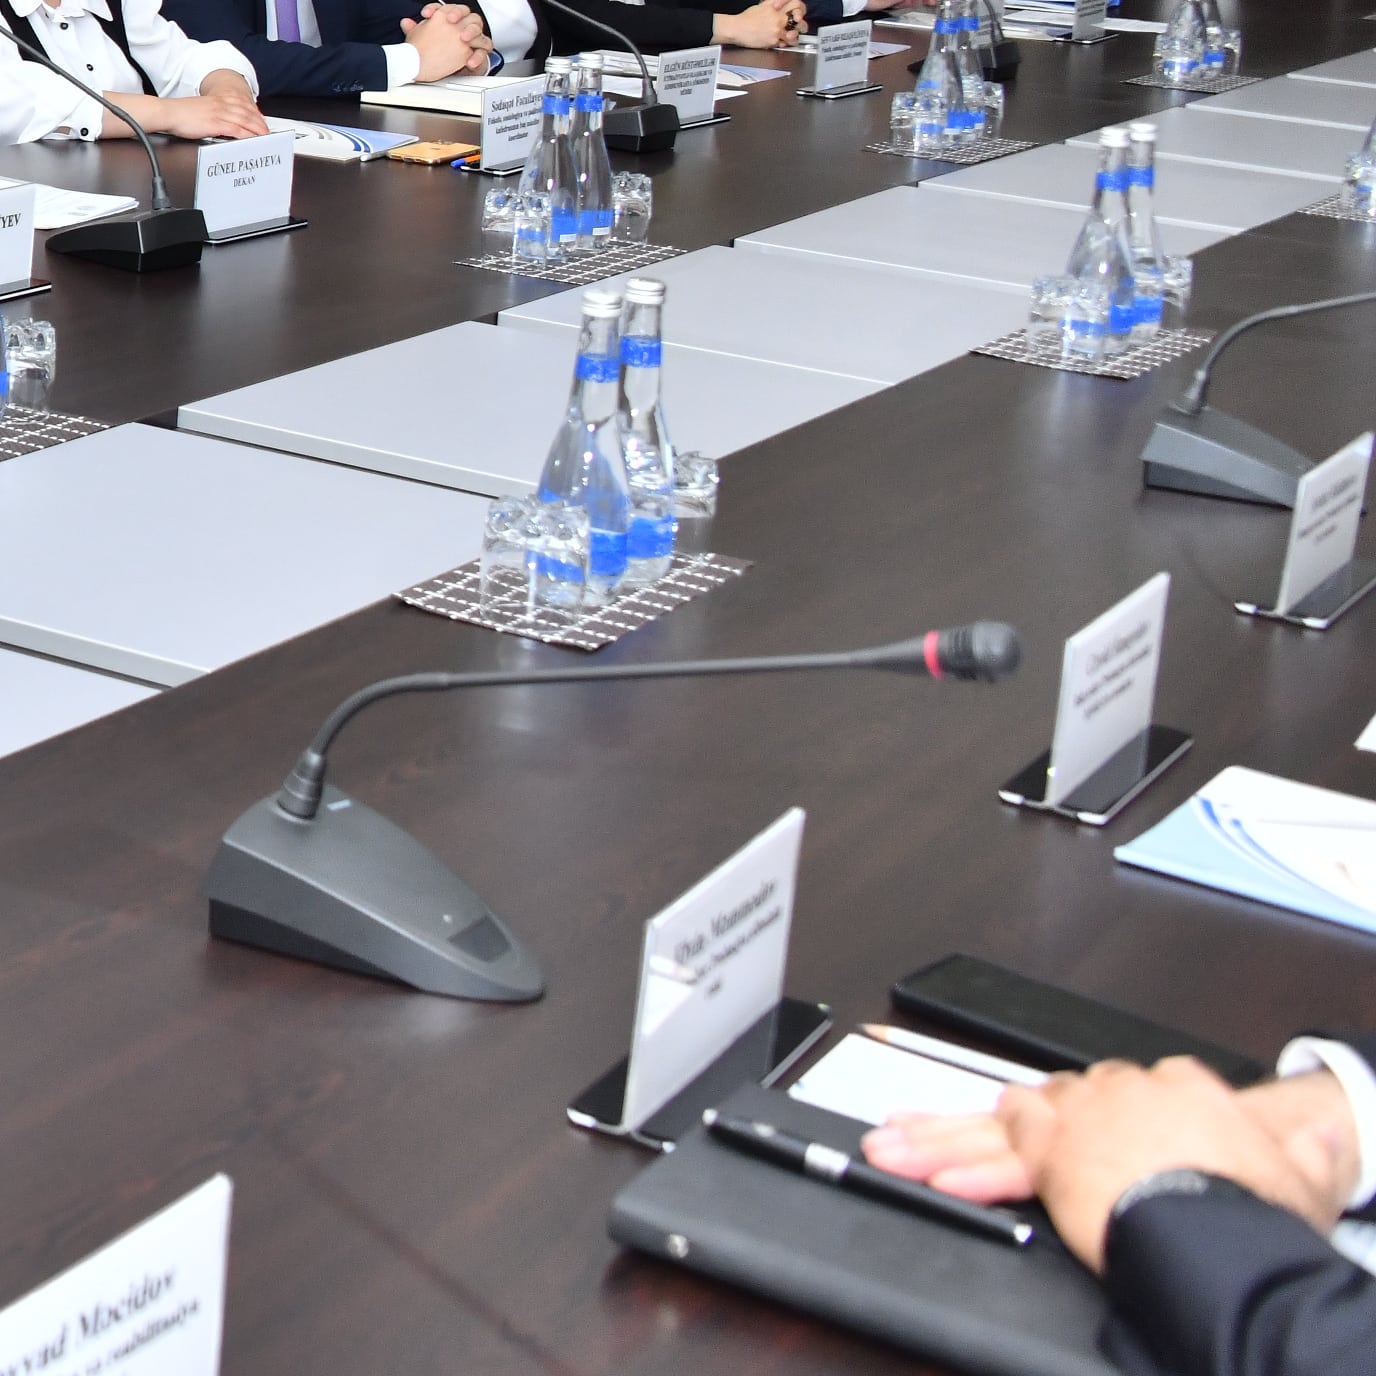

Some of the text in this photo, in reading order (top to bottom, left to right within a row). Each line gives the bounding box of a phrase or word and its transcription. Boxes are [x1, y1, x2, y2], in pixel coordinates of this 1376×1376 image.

[207, 155, 281, 177] GÜNEL PAŞAYEVA
[233, 175, 256, 187] DEKAN
